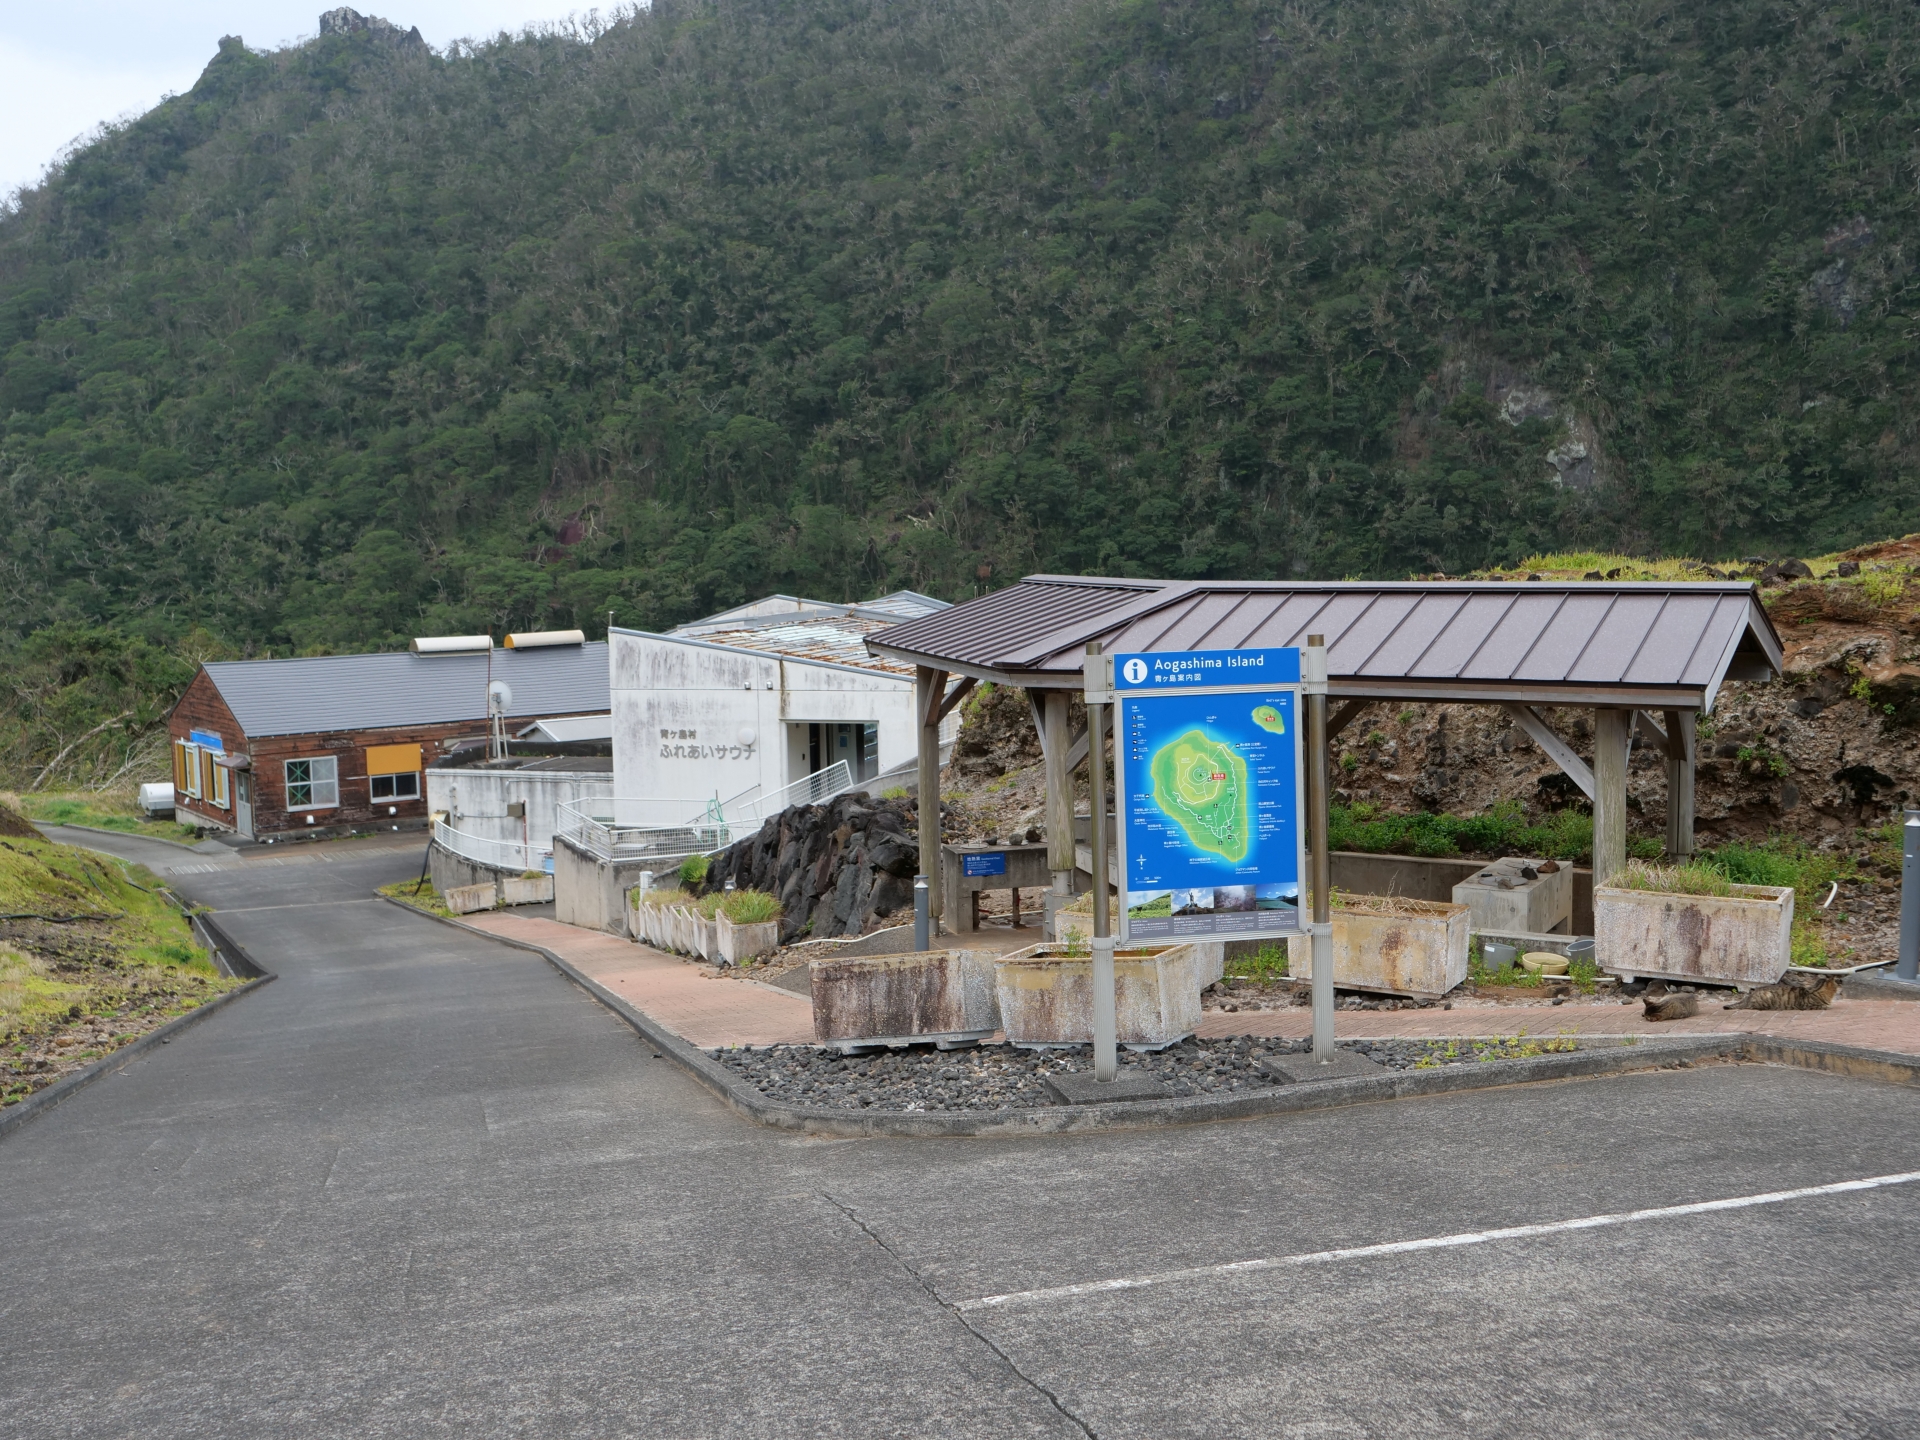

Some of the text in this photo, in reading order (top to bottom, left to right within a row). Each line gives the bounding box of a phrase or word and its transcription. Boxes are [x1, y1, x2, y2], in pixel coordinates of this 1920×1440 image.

[1154, 655, 1264, 672] Aogashima Island
[660, 729, 697, 740] 青ヶ島村
[660, 744, 756, 760] ふれあいサウナ
